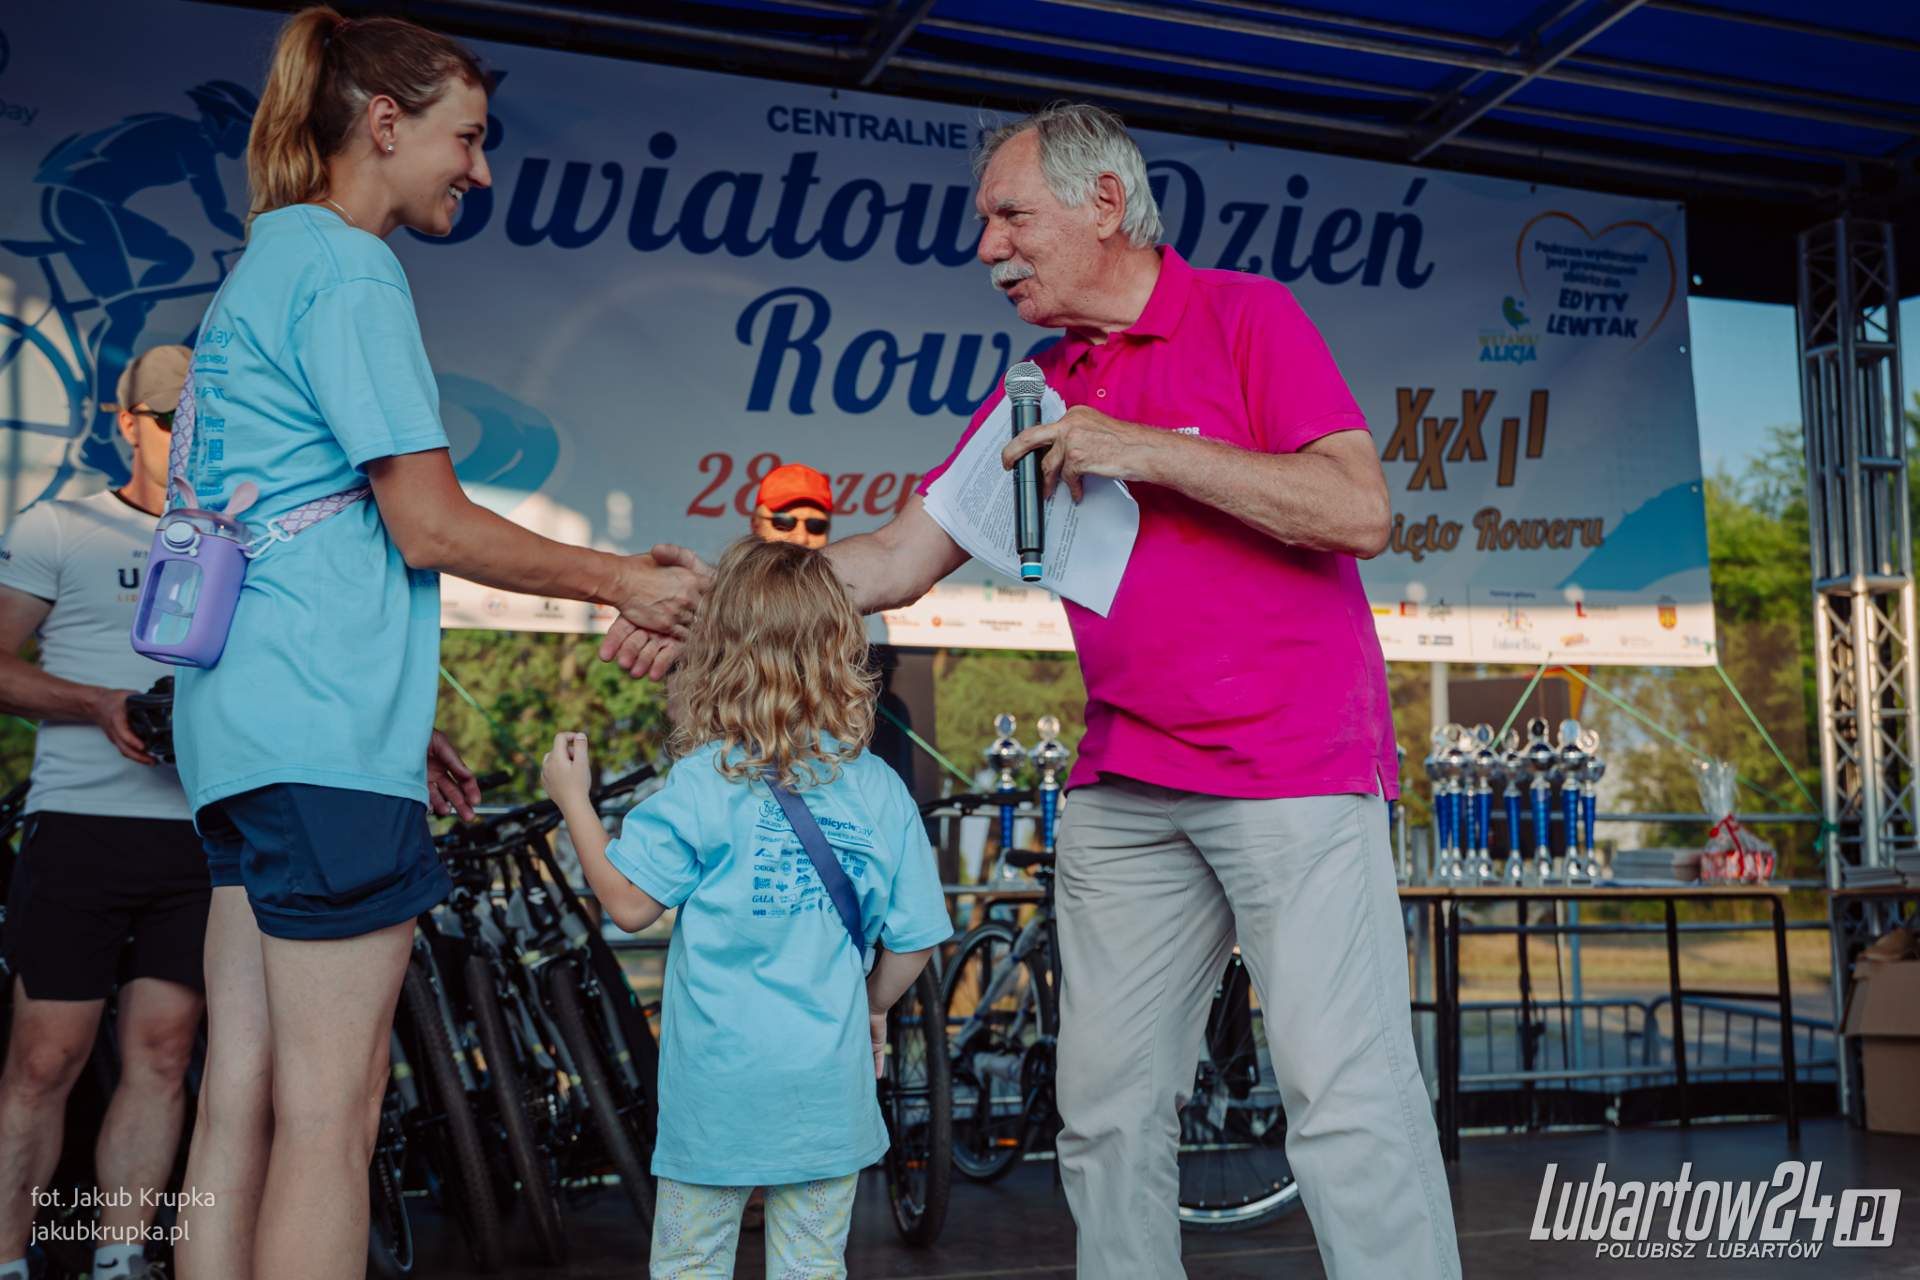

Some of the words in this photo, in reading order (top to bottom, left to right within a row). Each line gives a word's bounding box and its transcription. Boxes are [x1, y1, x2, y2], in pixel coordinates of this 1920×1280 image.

[767, 105, 968, 149] CENTRALNE
[404, 71, 985, 267] wiatow
[1146, 159, 1435, 289] Dzień
[1558, 288, 1629, 312] EDYTY
[1546, 313, 1639, 338] LEWTAK
[736, 287, 1065, 416] Row
[1480, 345, 1537, 365] ALICJA
[1390, 512, 1463, 562] ięto
[1473, 506, 1604, 551] Roweru
